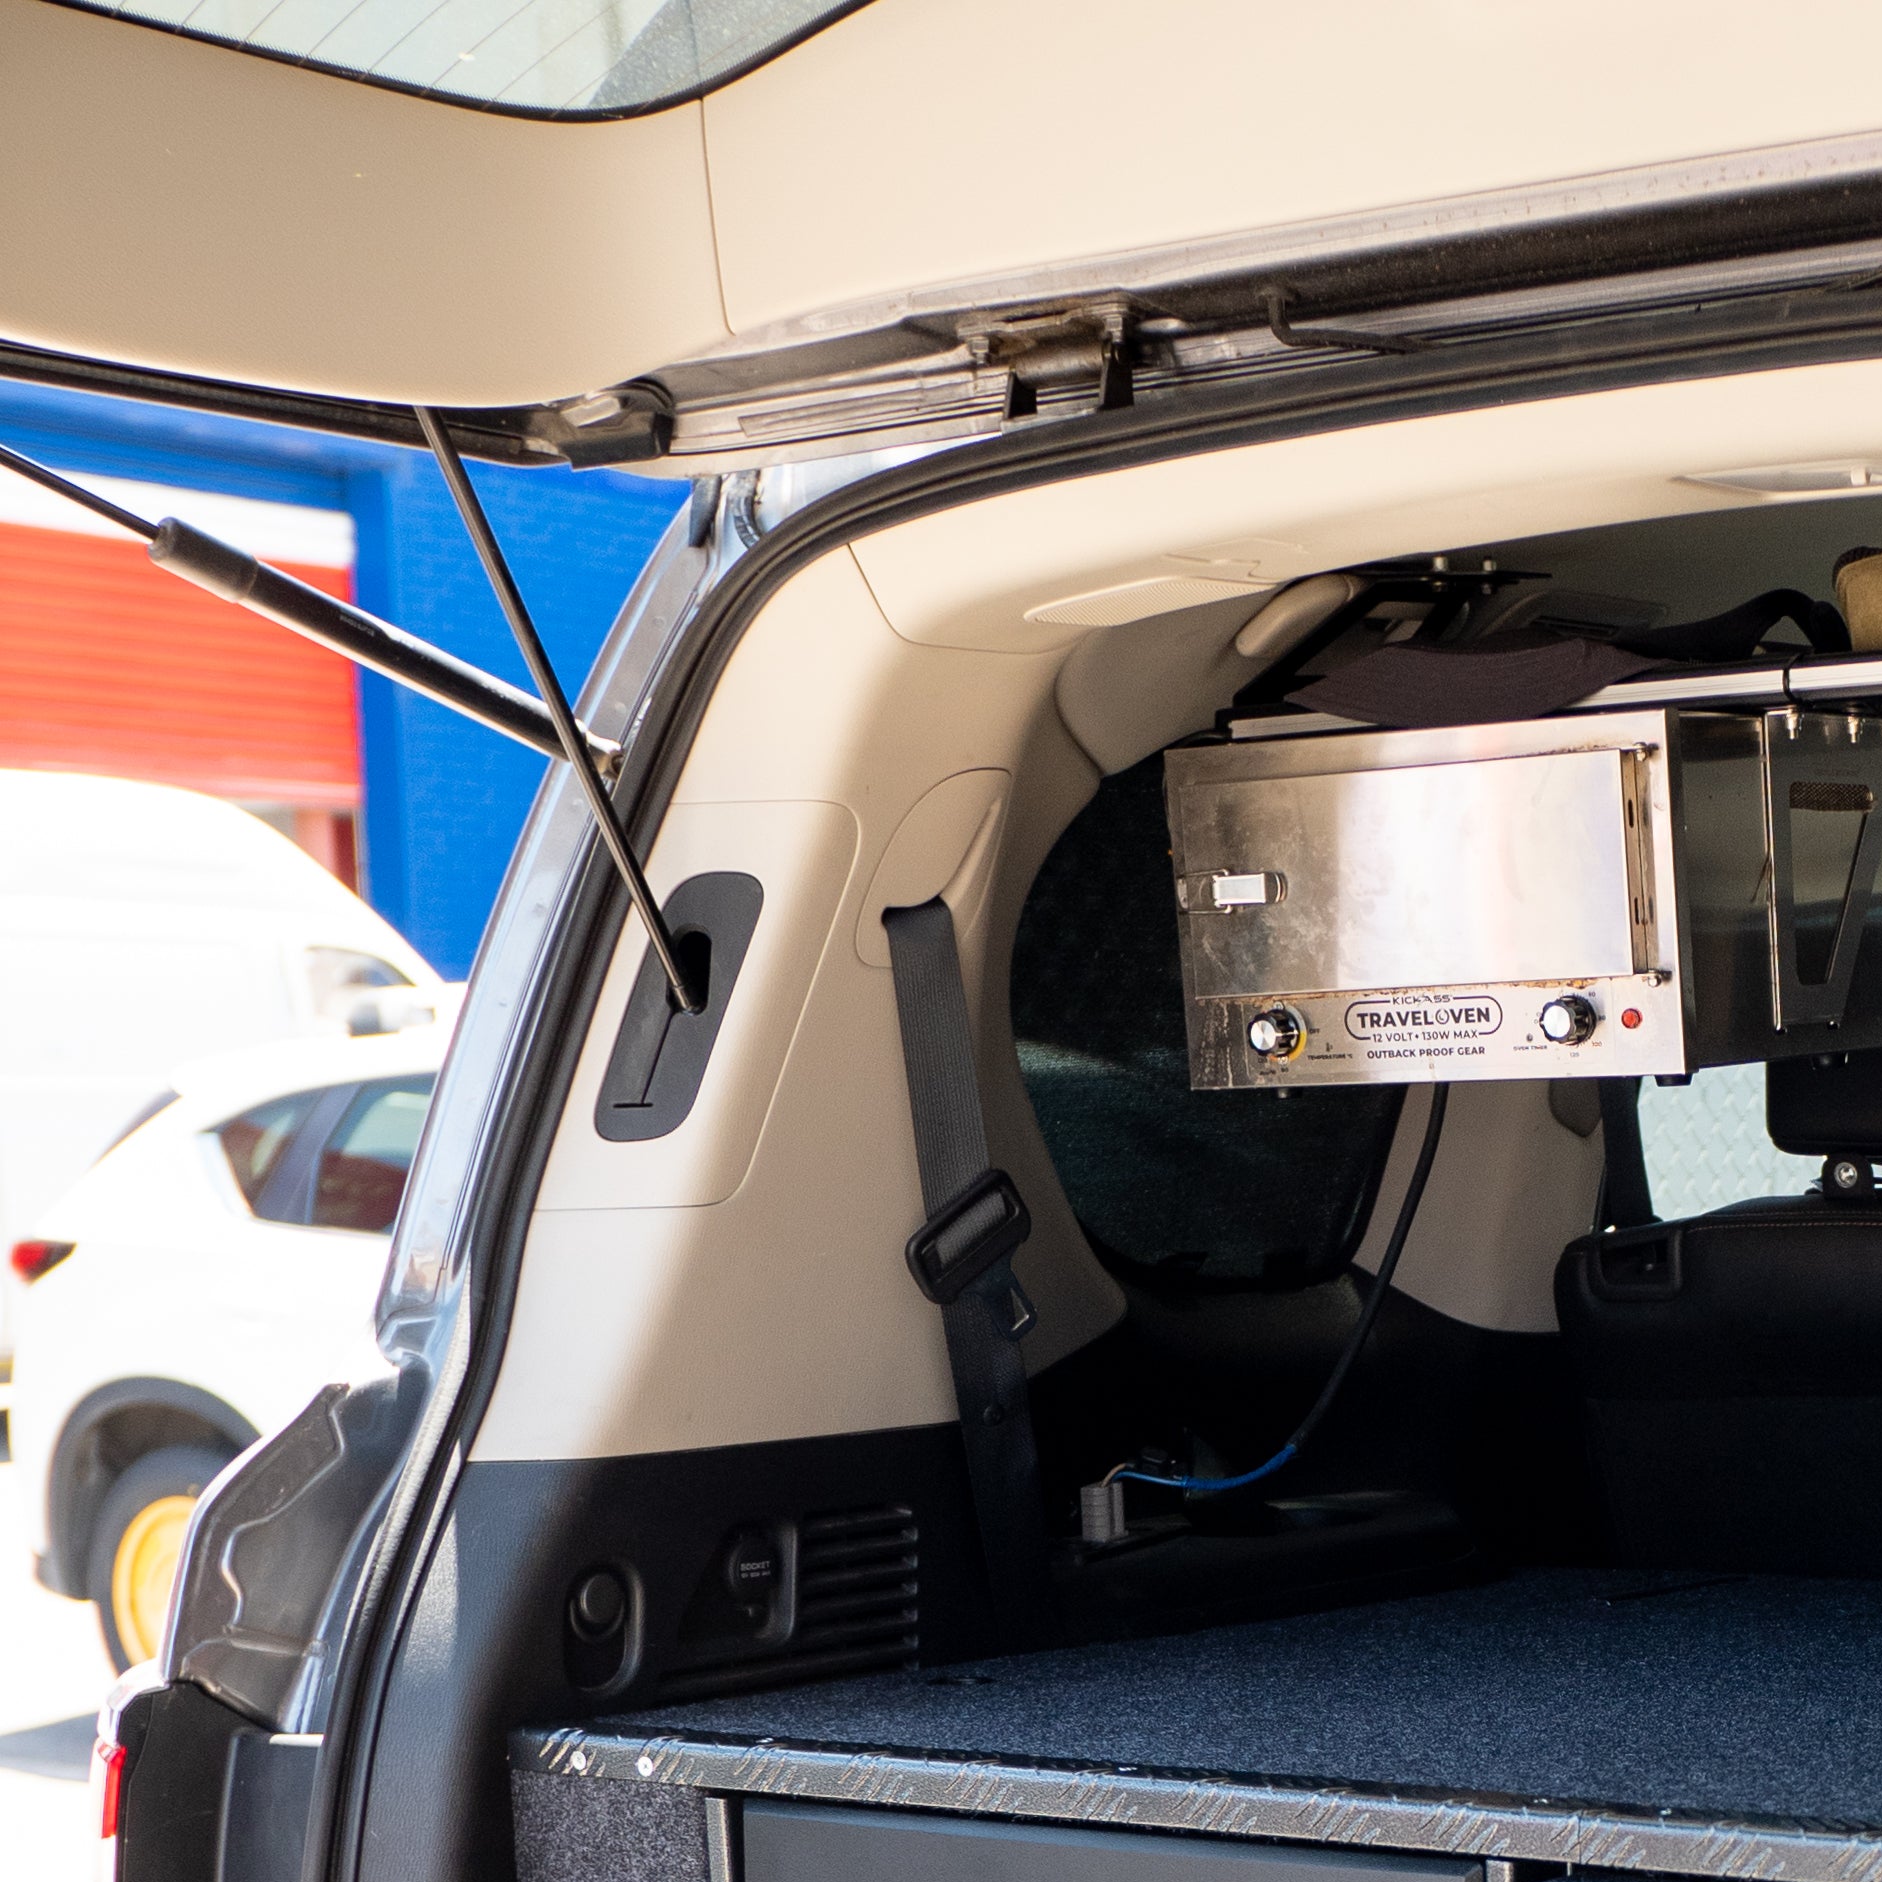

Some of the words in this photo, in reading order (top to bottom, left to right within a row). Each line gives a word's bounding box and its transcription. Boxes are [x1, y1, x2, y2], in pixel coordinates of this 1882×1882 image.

[1356, 1007, 1491, 1029] TRAVELOVEN
[1372, 1033, 1383, 1043] 12
[1386, 1032, 1413, 1043] VOLT
[1422, 1030, 1450, 1041] 130W
[1453, 1029, 1479, 1040] MAX
[1366, 1049, 1417, 1060] OUTBACK
[1419, 1047, 1454, 1058] PROOF
[1457, 1046, 1486, 1057] GEAR
